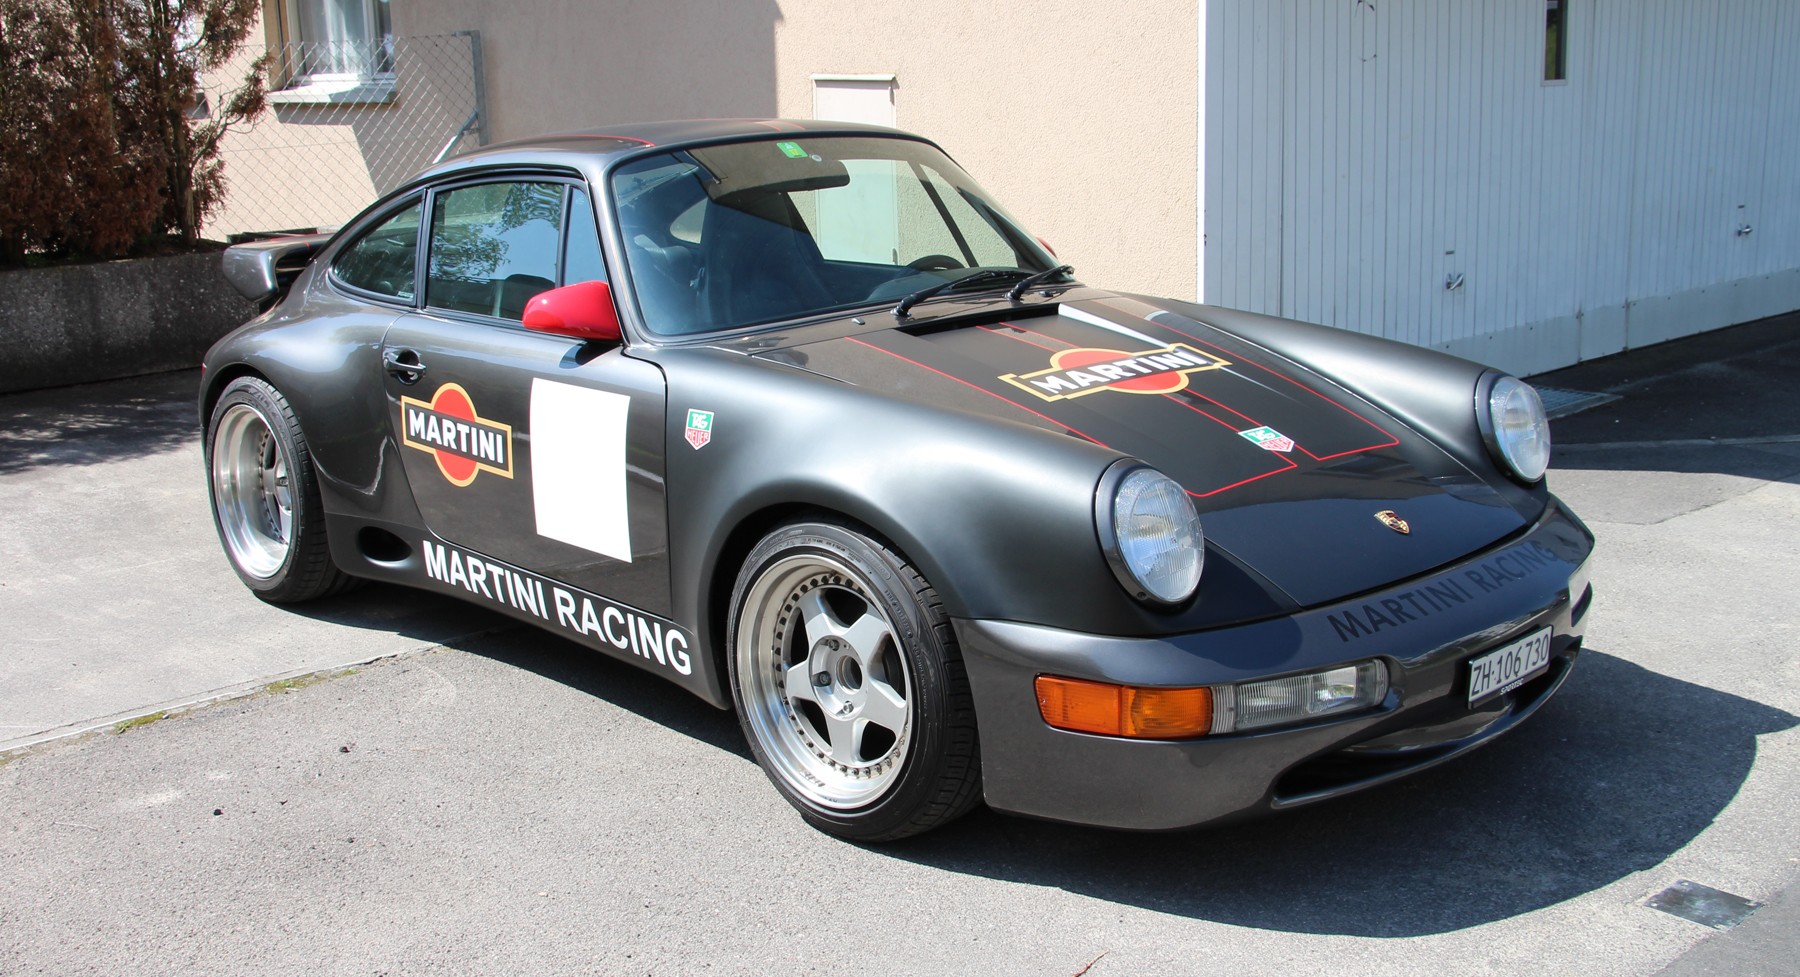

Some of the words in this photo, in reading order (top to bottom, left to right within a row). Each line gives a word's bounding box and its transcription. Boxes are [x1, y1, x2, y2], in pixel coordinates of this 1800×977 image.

[1030, 351, 1207, 394] MARTINI
[409, 408, 504, 464] MARTINI
[687, 428, 710, 447] HEUER
[692, 413, 708, 429] TAG
[423, 540, 549, 621] MARTINI
[552, 586, 692, 676] RACING
[1326, 577, 1474, 643] MARTINI
[1464, 539, 1558, 593] RACING
